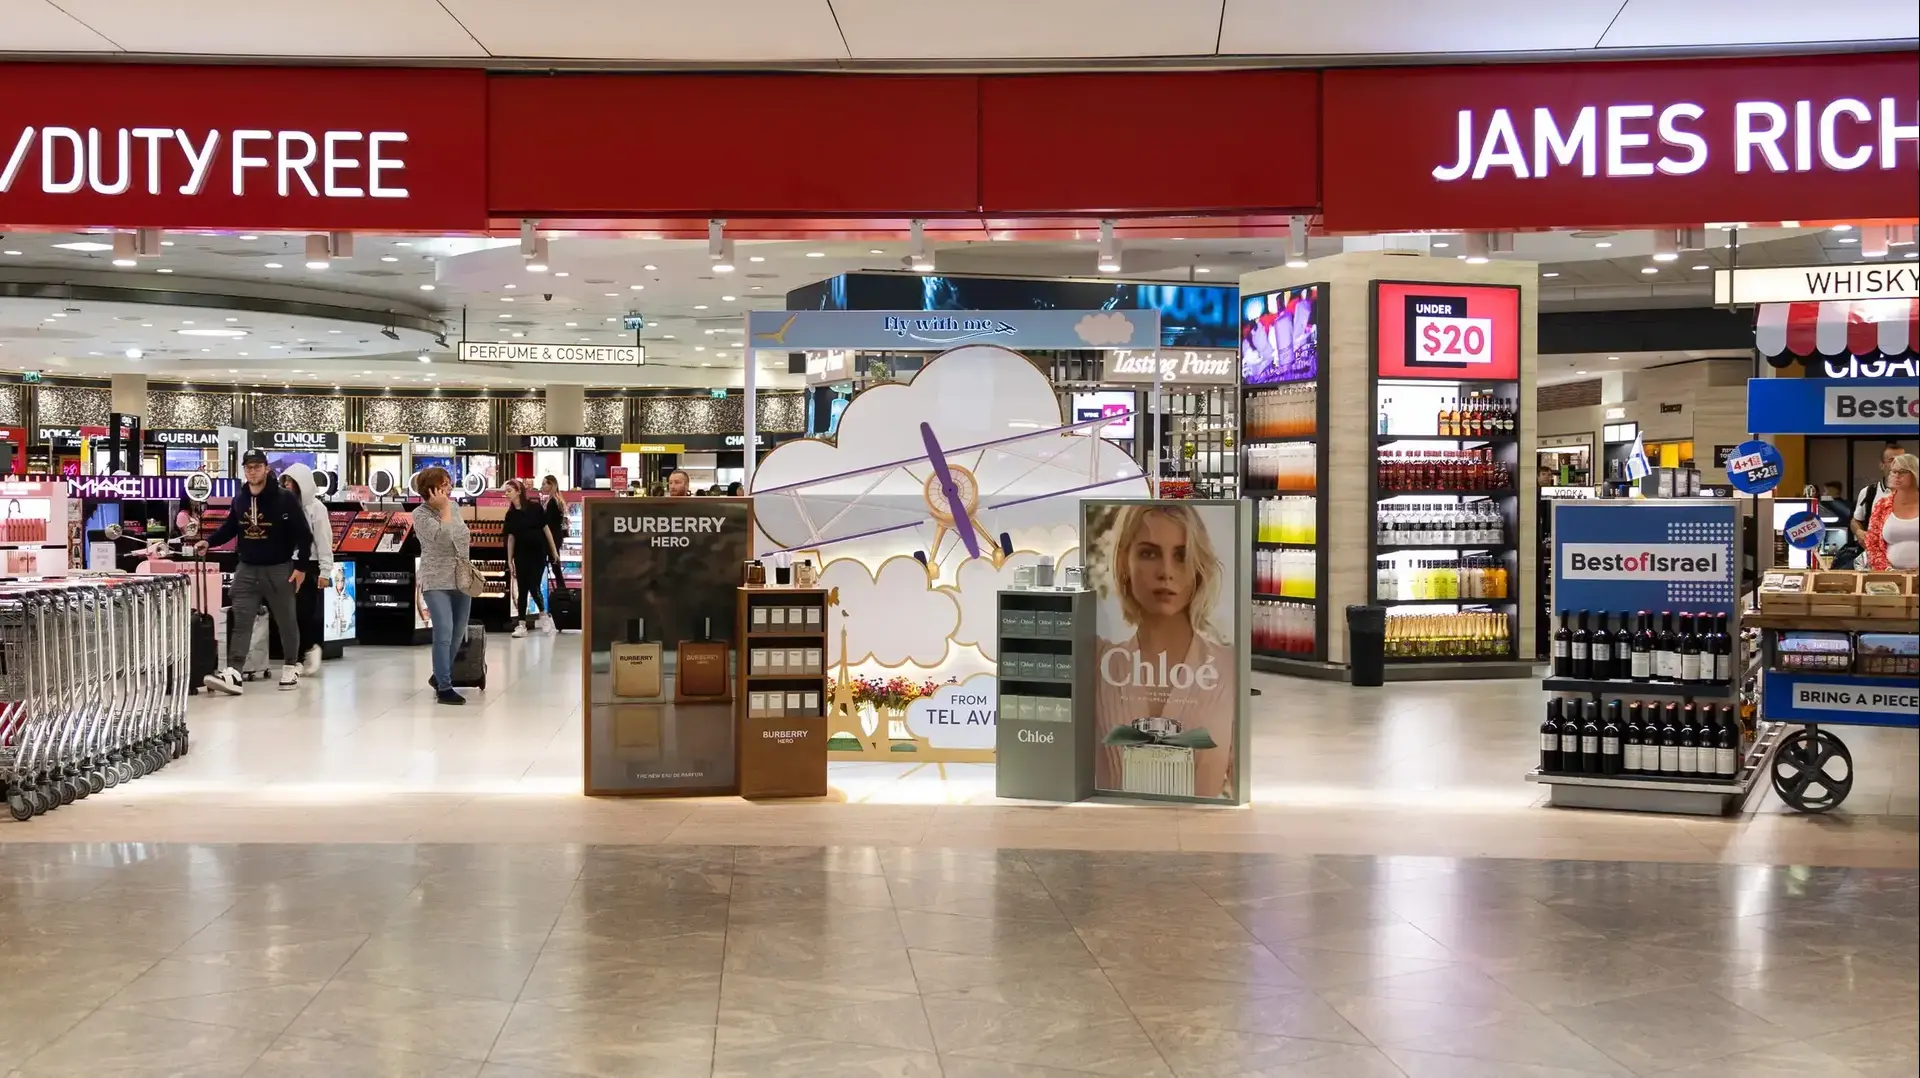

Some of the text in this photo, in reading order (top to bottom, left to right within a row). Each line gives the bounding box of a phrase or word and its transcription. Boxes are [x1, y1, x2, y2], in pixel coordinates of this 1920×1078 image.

[1432, 102, 1709, 181] JAMES
[232, 129, 409, 198] FREE
[1415, 303, 1452, 315] UNDER
[884, 316, 992, 337] Fly with me
[1422, 322, 1485, 357] $20
[469, 345, 635, 362] PERFUME & COSMETICS
[1113, 350, 1232, 381] Tasting Point
[158, 432, 220, 444] GUERLAIN
[273, 432, 326, 444] CLINIQUE
[530, 435, 559, 447] DIOR
[575, 435, 596, 448] DIOR
[725, 435, 765, 446] CHAEL
[1733, 457, 1755, 470] 4+1
[1747, 467, 1772, 482] 5+2
[1554, 488, 1584, 498] VODKA
[613, 516, 726, 533] BURBERRY
[1791, 521, 1817, 538] DATES
[650, 536, 690, 548] HERO
[1100, 647, 1219, 690] Chloé
[951, 694, 987, 706] FROM
[1799, 690, 1919, 708] BRING A PIECE
[926, 709, 996, 725] TEL AVI
[762, 730, 809, 739] BURBERRY
[1017, 729, 1055, 744] Chloé
